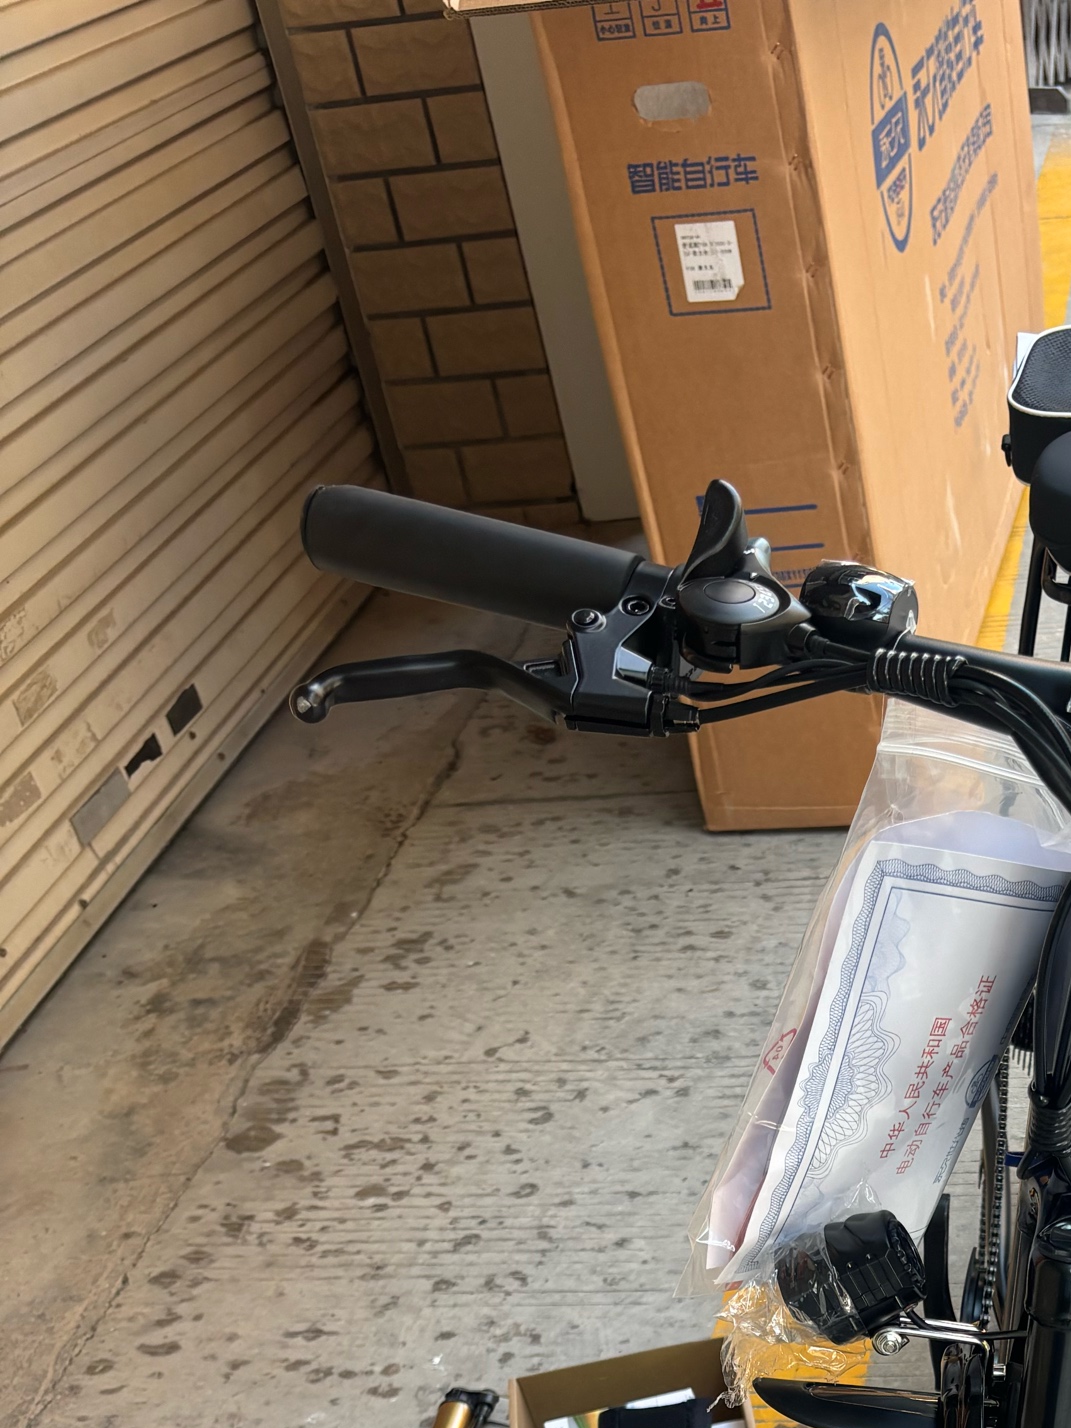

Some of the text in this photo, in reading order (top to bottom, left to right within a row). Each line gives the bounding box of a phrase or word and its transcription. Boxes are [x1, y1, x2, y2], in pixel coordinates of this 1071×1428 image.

[627, 153, 759, 195] 智能自行车
[880, 1017, 952, 1159] 中华人民共和国
[896, 975, 997, 1175] 电动自行车产品合格证
